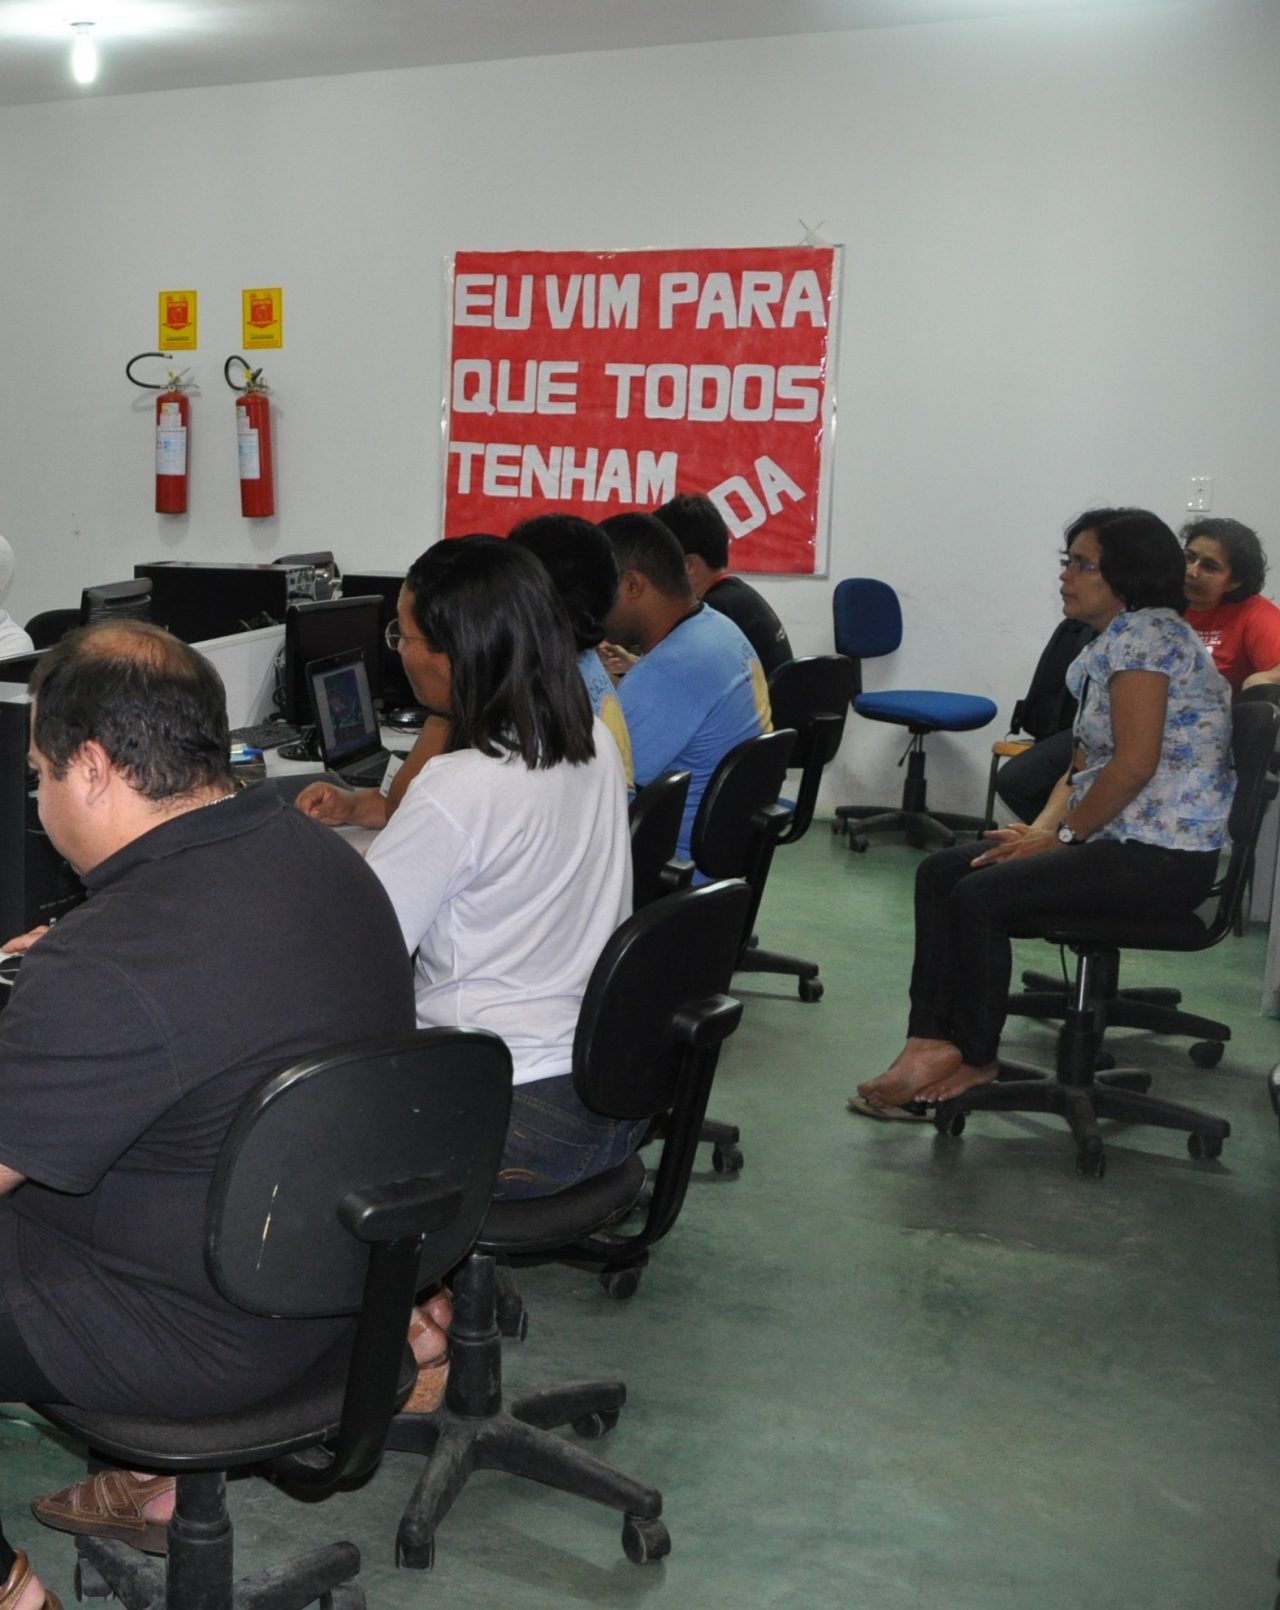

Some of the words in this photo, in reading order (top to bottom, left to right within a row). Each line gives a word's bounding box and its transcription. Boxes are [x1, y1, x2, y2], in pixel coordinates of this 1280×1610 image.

[453, 273, 534, 330] EU
[544, 273, 640, 330] VIM
[659, 270, 828, 330] PARA
[452, 358, 580, 416] QUE
[604, 363, 822, 423] TODOS
[448, 441, 678, 505] TENHAM
